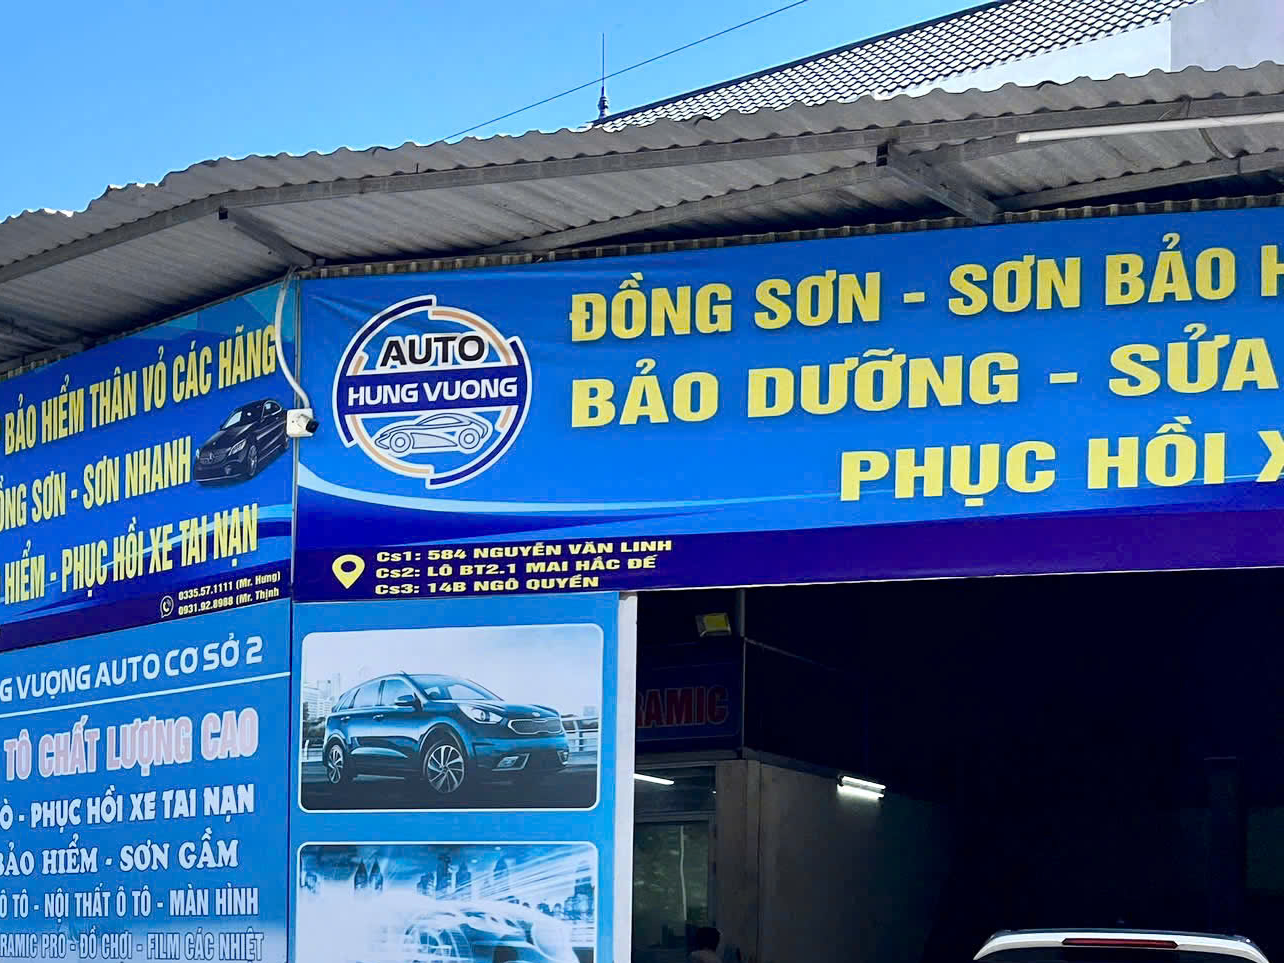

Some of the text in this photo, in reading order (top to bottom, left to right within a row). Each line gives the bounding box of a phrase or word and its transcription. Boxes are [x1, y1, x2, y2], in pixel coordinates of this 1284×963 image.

[569, 271, 732, 342] ĐỒNG
[753, 269, 881, 330] SƠN
[903, 291, 925, 304] -
[948, 254, 1081, 316] SƠN
[1105, 232, 1236, 306] BẢO
[378, 334, 486, 368] AUTO
[571, 322, 1279, 428] BẢO DƯỠNG - SỬA
[4, 393, 37, 456] BẢO
[41, 374, 85, 444] HIỂM
[89, 366, 137, 429] THÂN
[142, 345, 166, 412] VỎ
[172, 339, 212, 403] CÁC
[218, 324, 276, 389] HÃNG
[347, 376, 518, 407] HUNG VUONG
[31, 470, 66, 523] SƠN
[83, 455, 120, 510] SƠN
[125, 435, 191, 499] NHANH
[840, 440, 1057, 508] PHỤC
[1087, 415, 1226, 490] HỒI
[4, 539, 45, 605] HIỂM
[61, 539, 108, 597] PHỤC
[113, 516, 144, 581] HỒI
[148, 523, 173, 574] XE
[179, 515, 208, 567] TAI
[213, 503, 258, 567] NẠN
[375, 567, 421, 579] Cs2:
[427, 563, 453, 577] LÔ
[459, 563, 516, 576] BT2.1
[525, 561, 569, 573] MAI
[376, 540, 672, 562] Cs1: 584 NGUYỄN VĂN LINH
[374, 583, 420, 595] Cs3:
[427, 581, 467, 593] 14B
[473, 577, 519, 592] NGÔ
[16, 664, 91, 700] VƯỢNG
[94, 653, 160, 689] AUTO
[165, 647, 199, 677] CƠ
[202, 632, 240, 672] SỞ
[246, 635, 263, 665] 2
[3, 728, 32, 781] TÔ
[38, 714, 101, 778] CHẤT
[106, 716, 193, 777] LƯỢNG
[200, 707, 259, 761] CAO
[30, 798, 82, 834] PHỤC
[86, 784, 124, 824] HỒI
[129, 791, 157, 821] XE
[162, 788, 197, 819] TAI
[203, 783, 255, 823] NẠN
[41, 832, 98, 875] HIỂM
[119, 839, 170, 872] SƠN
[178, 826, 239, 870] GẦM
[12, 888, 29, 918] TÔ
[44, 887, 69, 923] NỘI
[74, 882, 111, 918] THẤT
[116, 885, 127, 917] Ô
[131, 884, 152, 917] TÔ
[169, 883, 209, 917] MÀN
[215, 882, 259, 917] HÌNH
[41, 932, 67, 958] PRO
[78, 925, 98, 959] ĐỒ
[101, 931, 133, 960] CHƠI
[147, 932, 181, 960] FILM
[184, 927, 215, 961] CÁC
